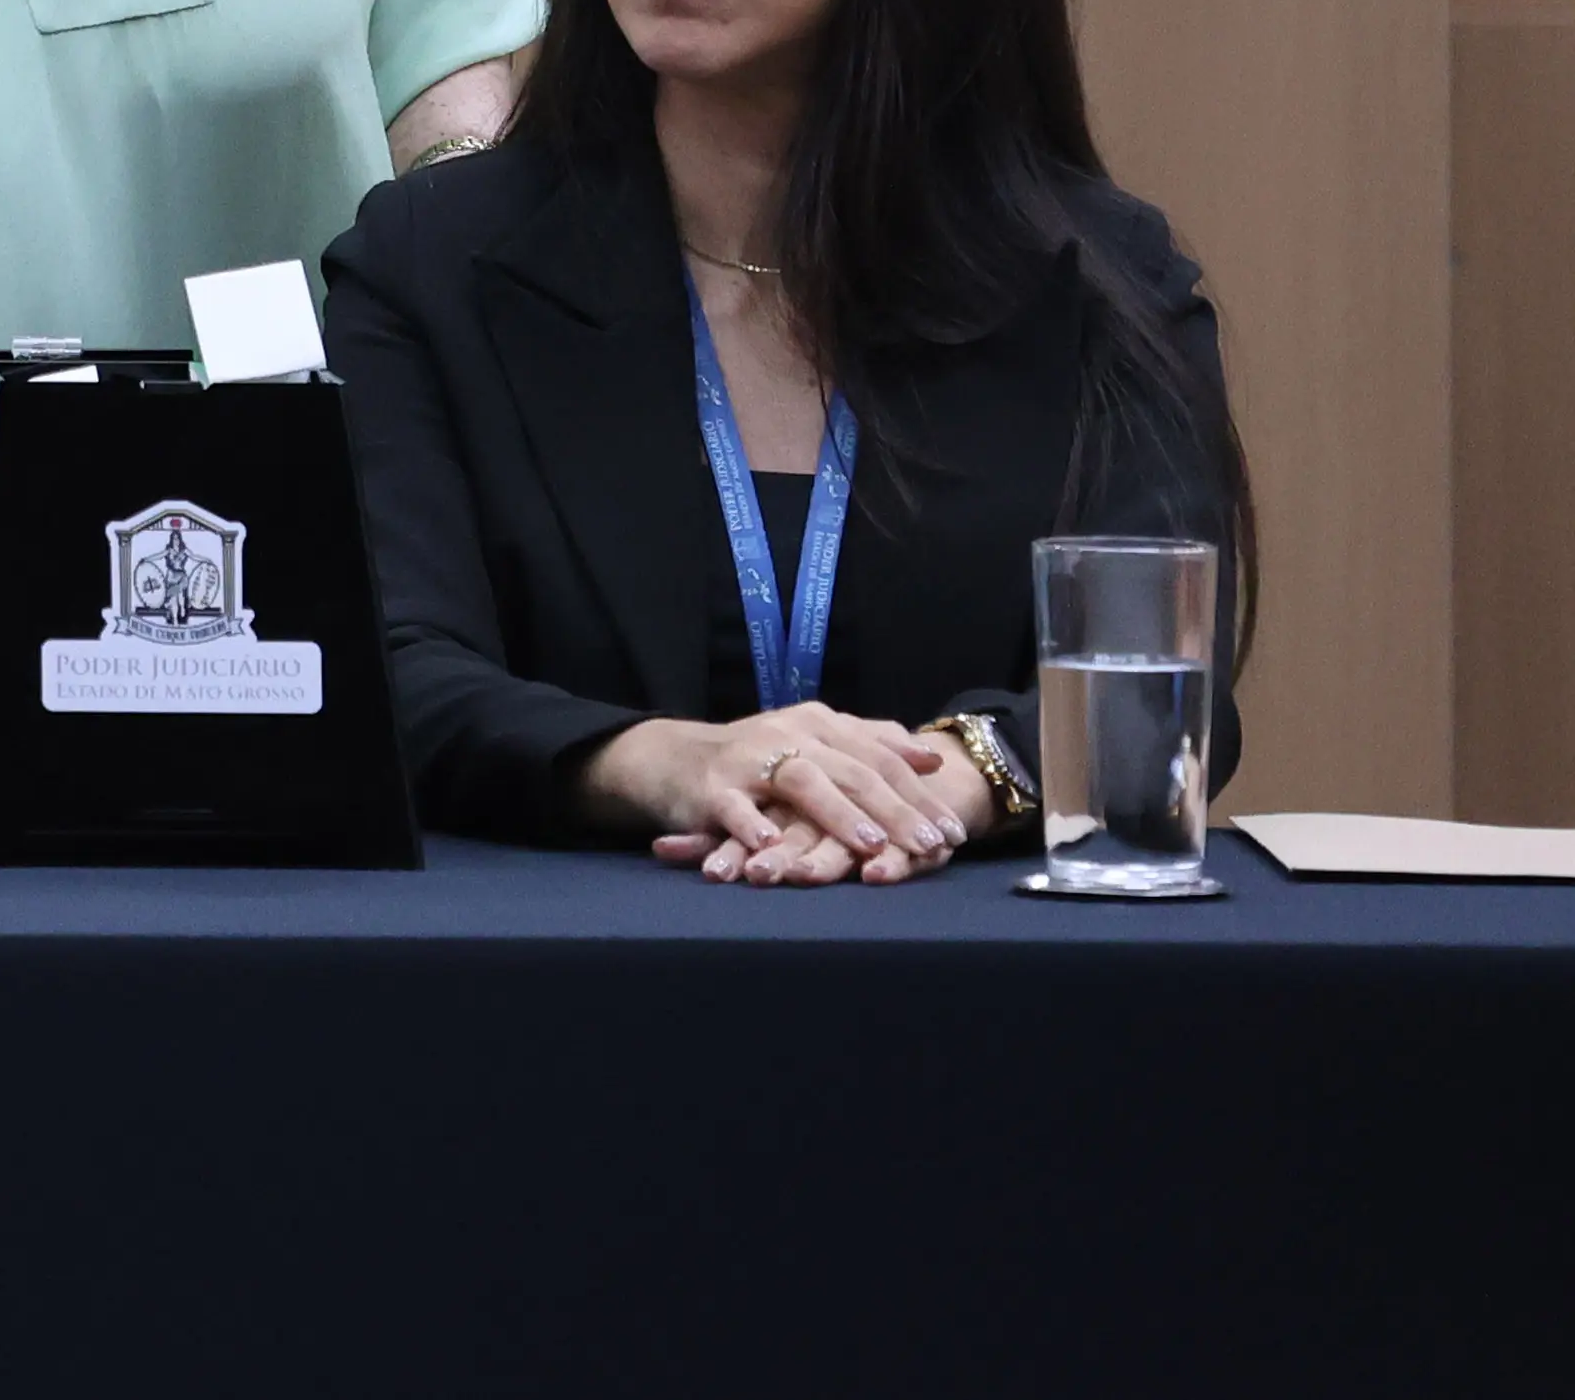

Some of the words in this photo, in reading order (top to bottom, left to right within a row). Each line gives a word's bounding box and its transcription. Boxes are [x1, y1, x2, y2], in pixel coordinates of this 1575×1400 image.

[56, 654, 142, 677] PODER
[151, 652, 302, 682] JUDICIÁRIO
[56, 681, 128, 701] ESTADO
[135, 683, 158, 701] DE
[164, 683, 222, 701] MATO
[227, 683, 305, 702] GROSSO
